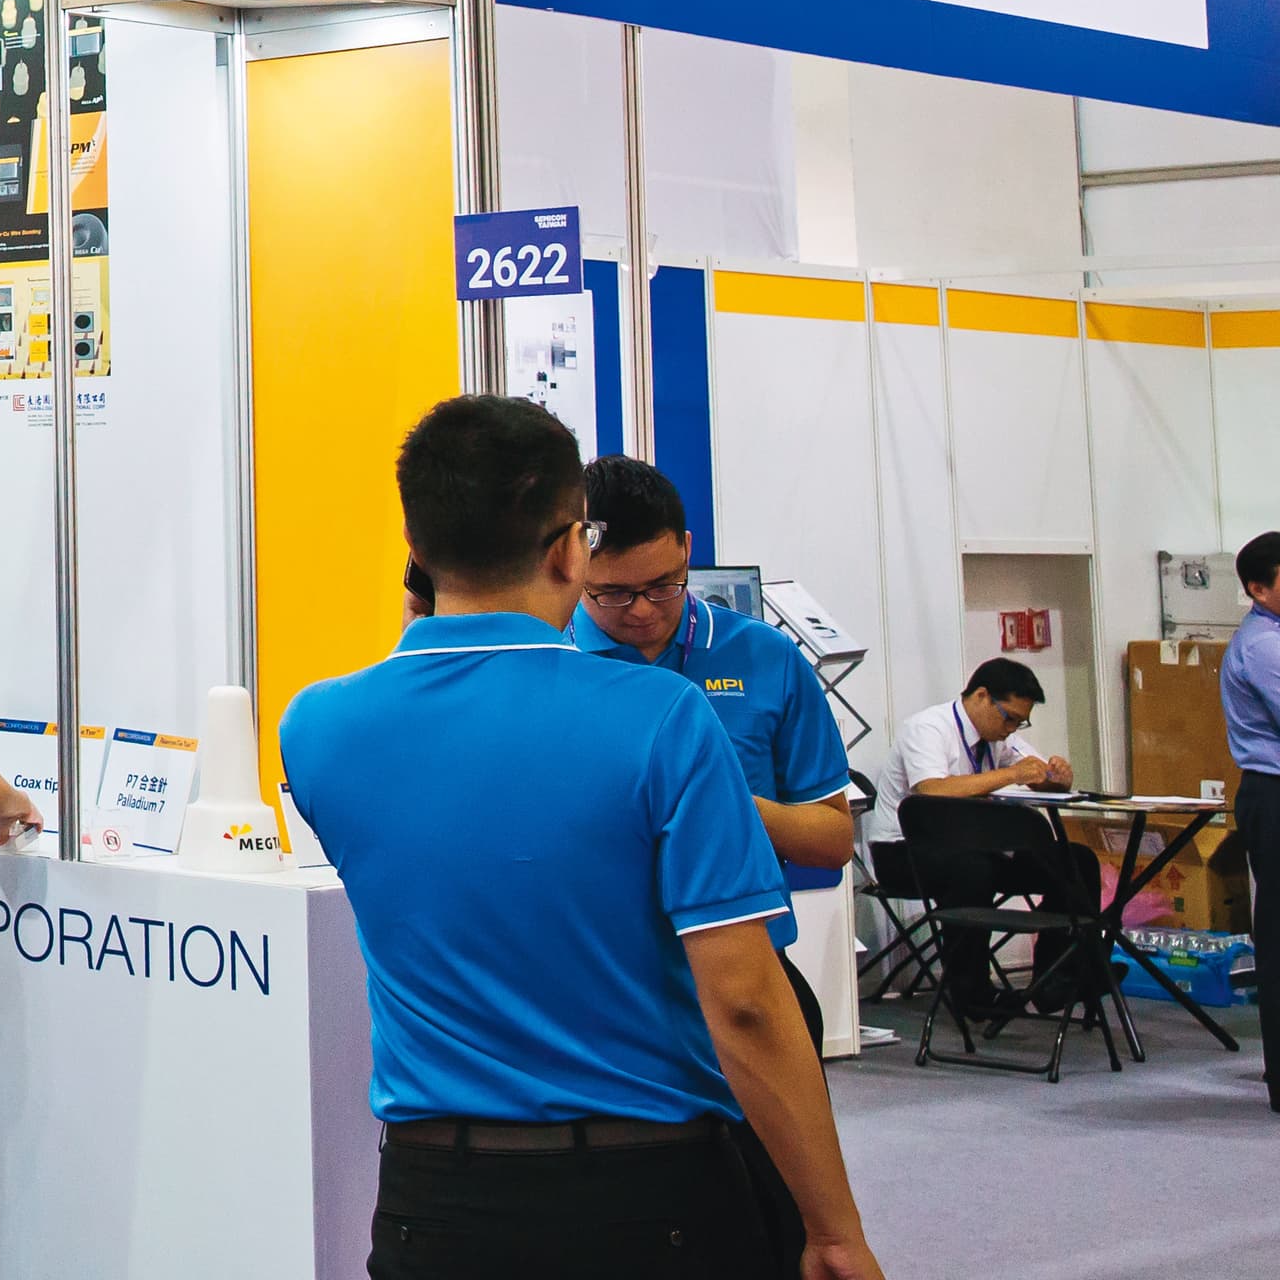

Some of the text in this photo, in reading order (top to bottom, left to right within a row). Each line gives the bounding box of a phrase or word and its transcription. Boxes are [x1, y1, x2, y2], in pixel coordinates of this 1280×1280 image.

[467, 243, 569, 289] 2622
[705, 678, 744, 691] MPI
[14, 774, 41, 789] Coax
[126, 774, 138, 788] P7
[116, 793, 165, 813] Palladium 7
[240, 837, 281, 850] MEGT
